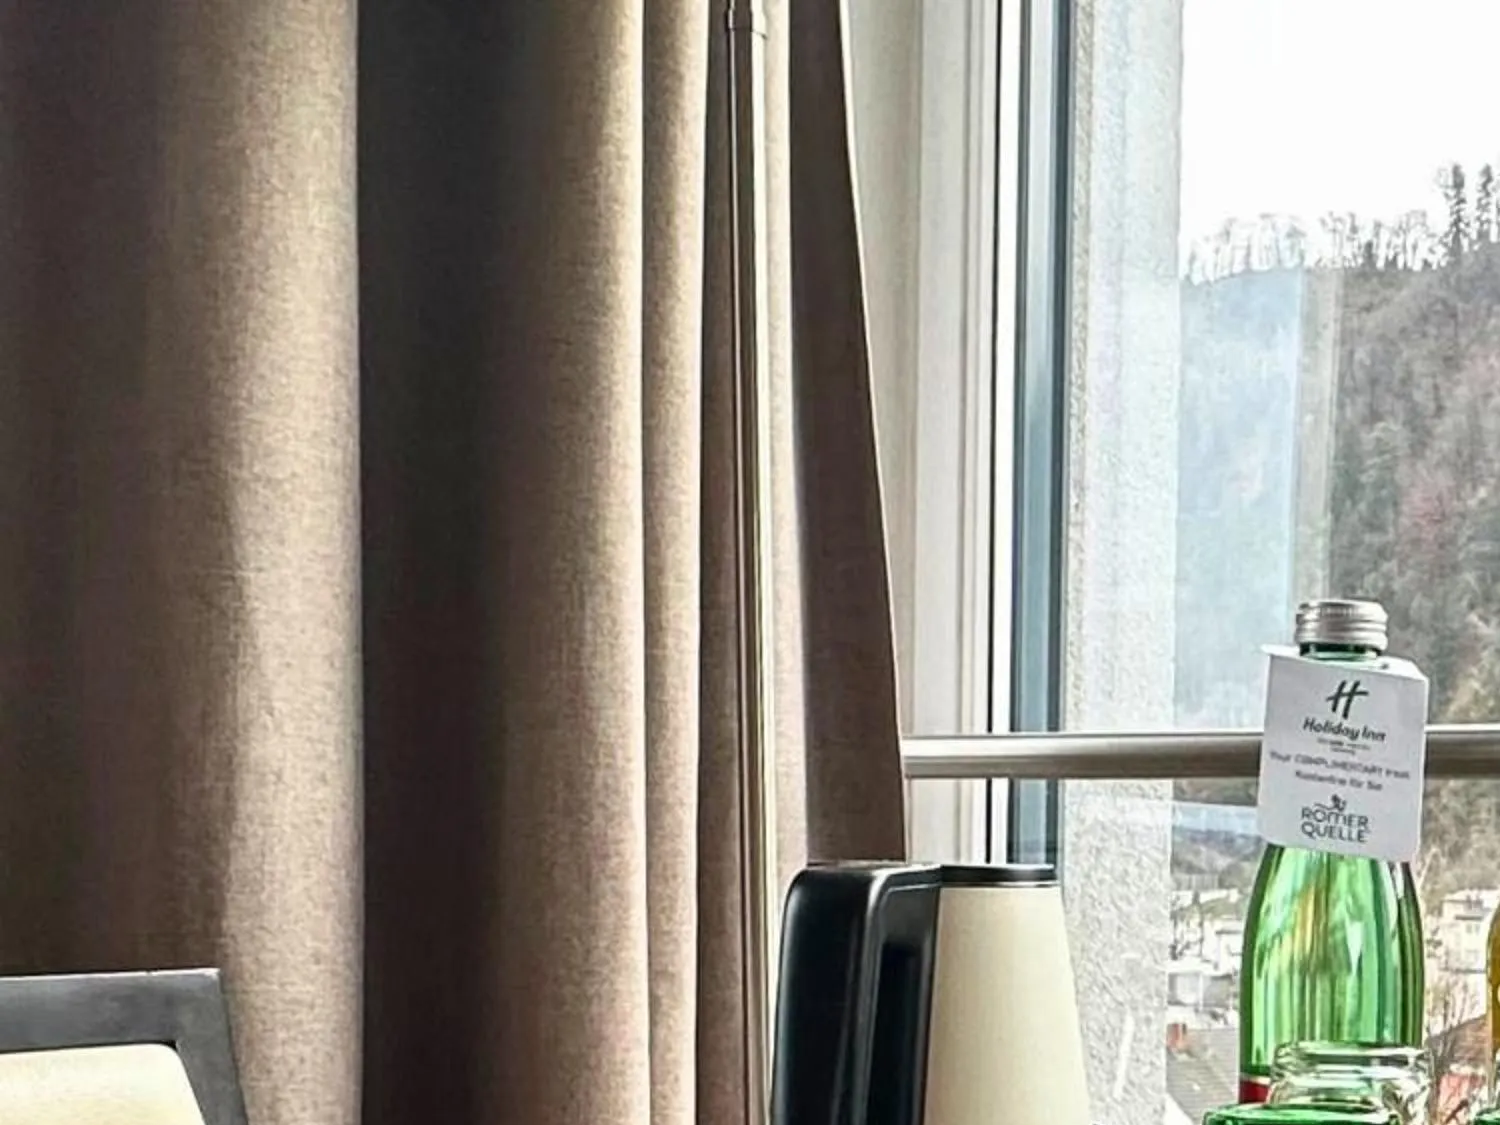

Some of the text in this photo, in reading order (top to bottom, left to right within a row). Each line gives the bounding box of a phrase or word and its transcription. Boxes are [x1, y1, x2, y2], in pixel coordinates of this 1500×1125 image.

[1302, 717, 1387, 743] Holiday Inn
[1300, 821, 1369, 844] QUELLE
